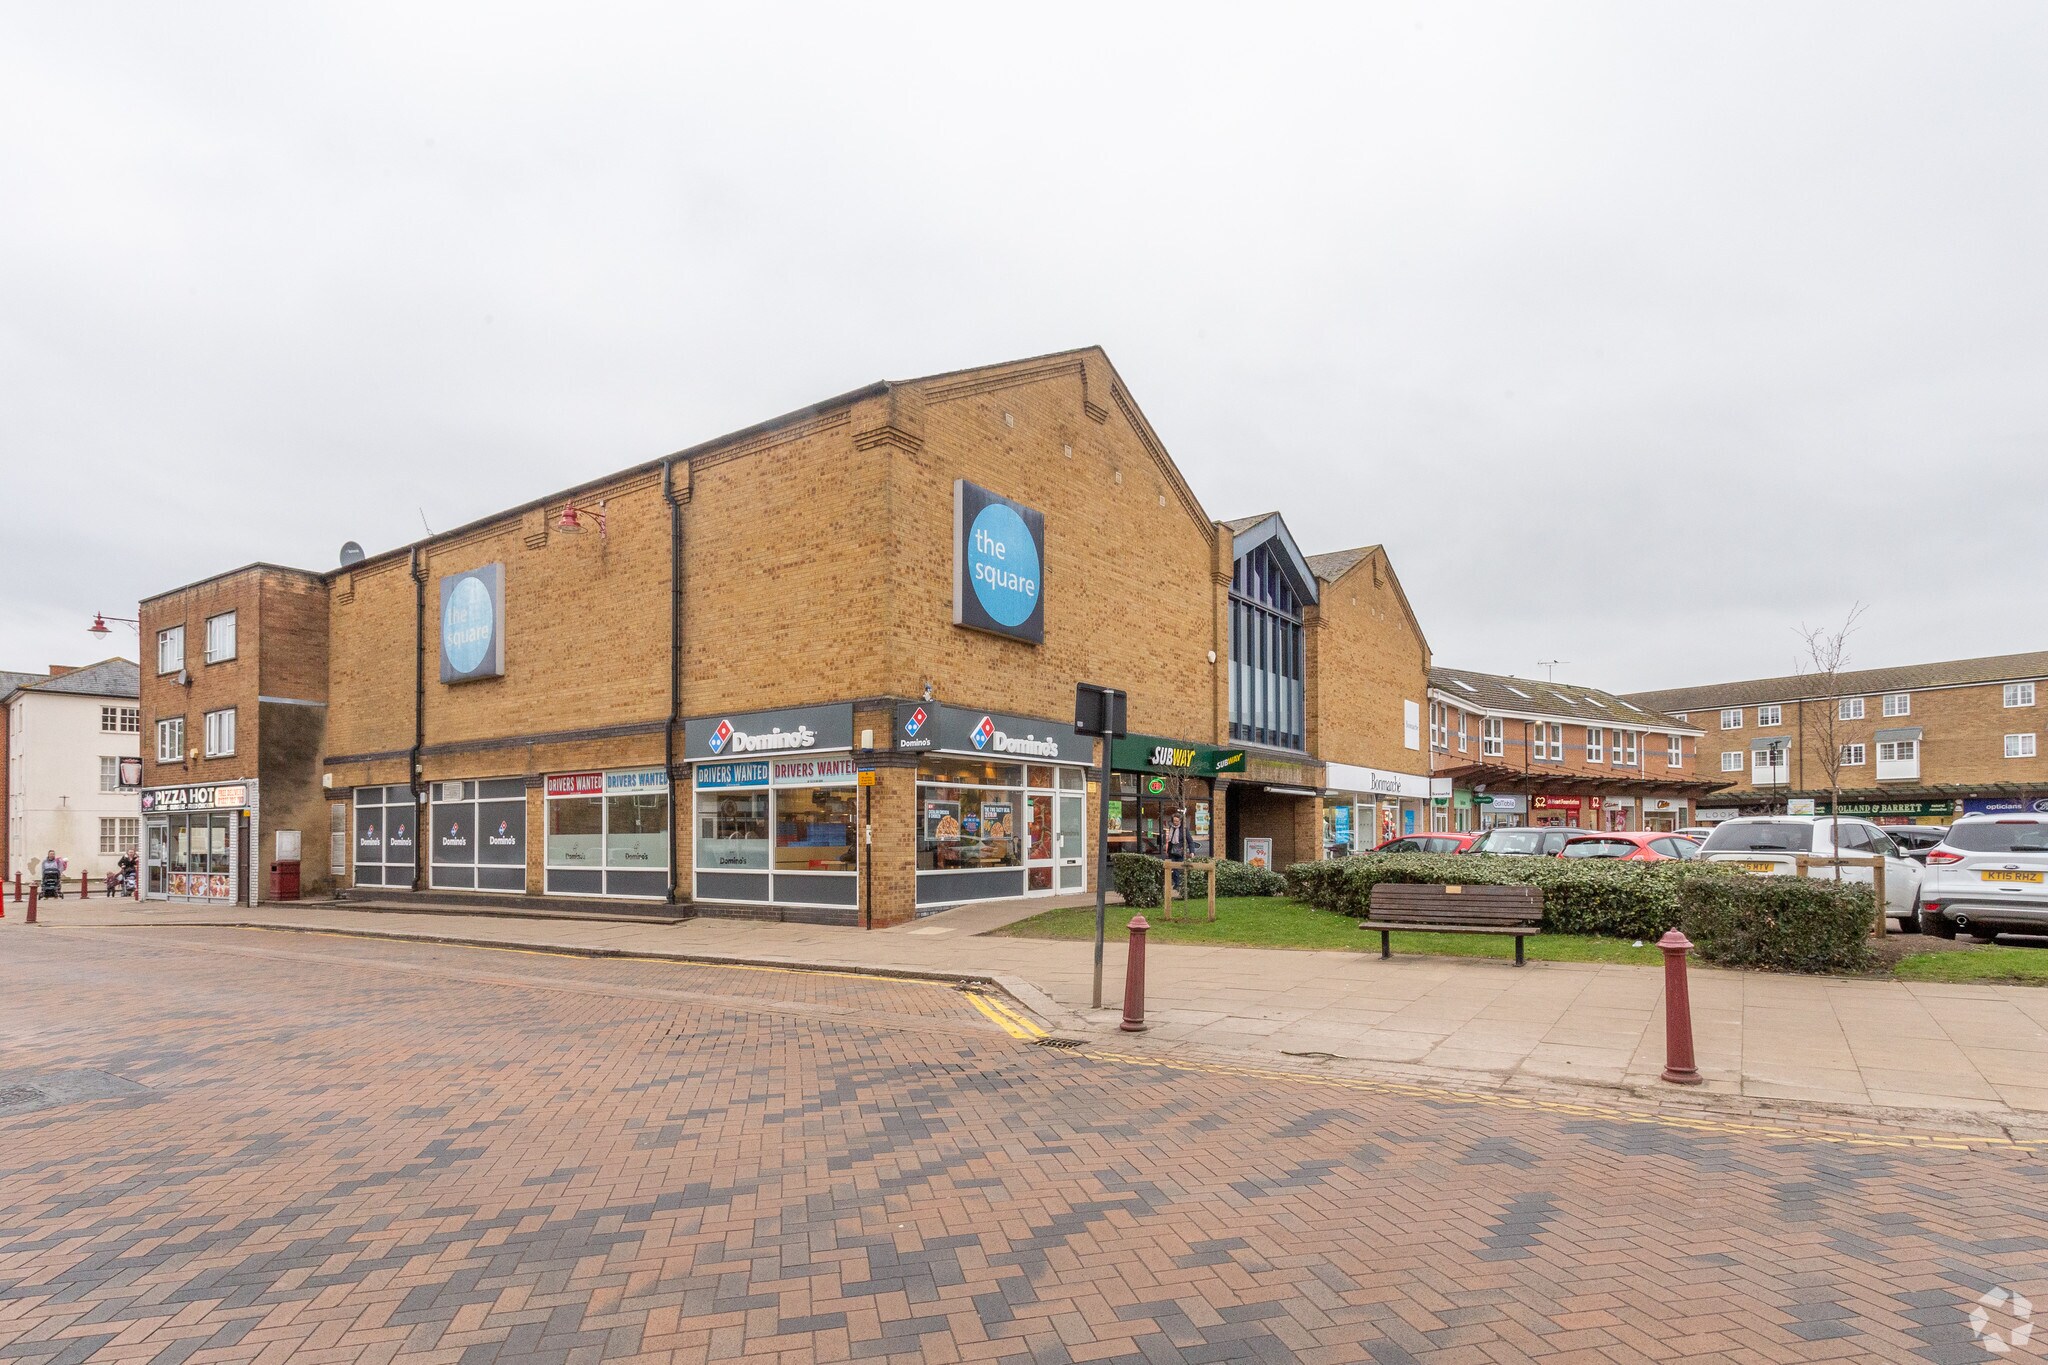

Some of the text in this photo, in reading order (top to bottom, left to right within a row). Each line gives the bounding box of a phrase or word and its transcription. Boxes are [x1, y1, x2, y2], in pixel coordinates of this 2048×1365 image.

[975, 529, 1006, 560] the
[975, 562, 1035, 597] square
[448, 607, 467, 626] the
[447, 625, 489, 648] square
[732, 725, 815, 752] Domino's
[900, 738, 931, 748] Domino's
[993, 731, 1058, 757] Domino's
[1151, 746, 1196, 768] SUBWAY
[1215, 753, 1243, 770] SUBWAY
[698, 763, 768, 783] DRIVERS WANTED
[774, 760, 857, 779] DRIVERS WANTED
[548, 774, 602, 792] DRIVERS WANTED
[607, 772, 668, 788] DRIVERS WANTED
[1371, 772, 1402, 793] Bonmarché
[154, 791, 187, 805] PIZZA
[189, 787, 215, 803] HOT
[1872, 804, 1879, 813] &
[1883, 803, 1922, 813] BARRETT
[361, 838, 380, 846] Domino's
[391, 837, 412, 846] Domino's
[443, 837, 466, 846] Domino's
[490, 835, 515, 845] Domino's
[1988, 872, 2012, 880] KT15
